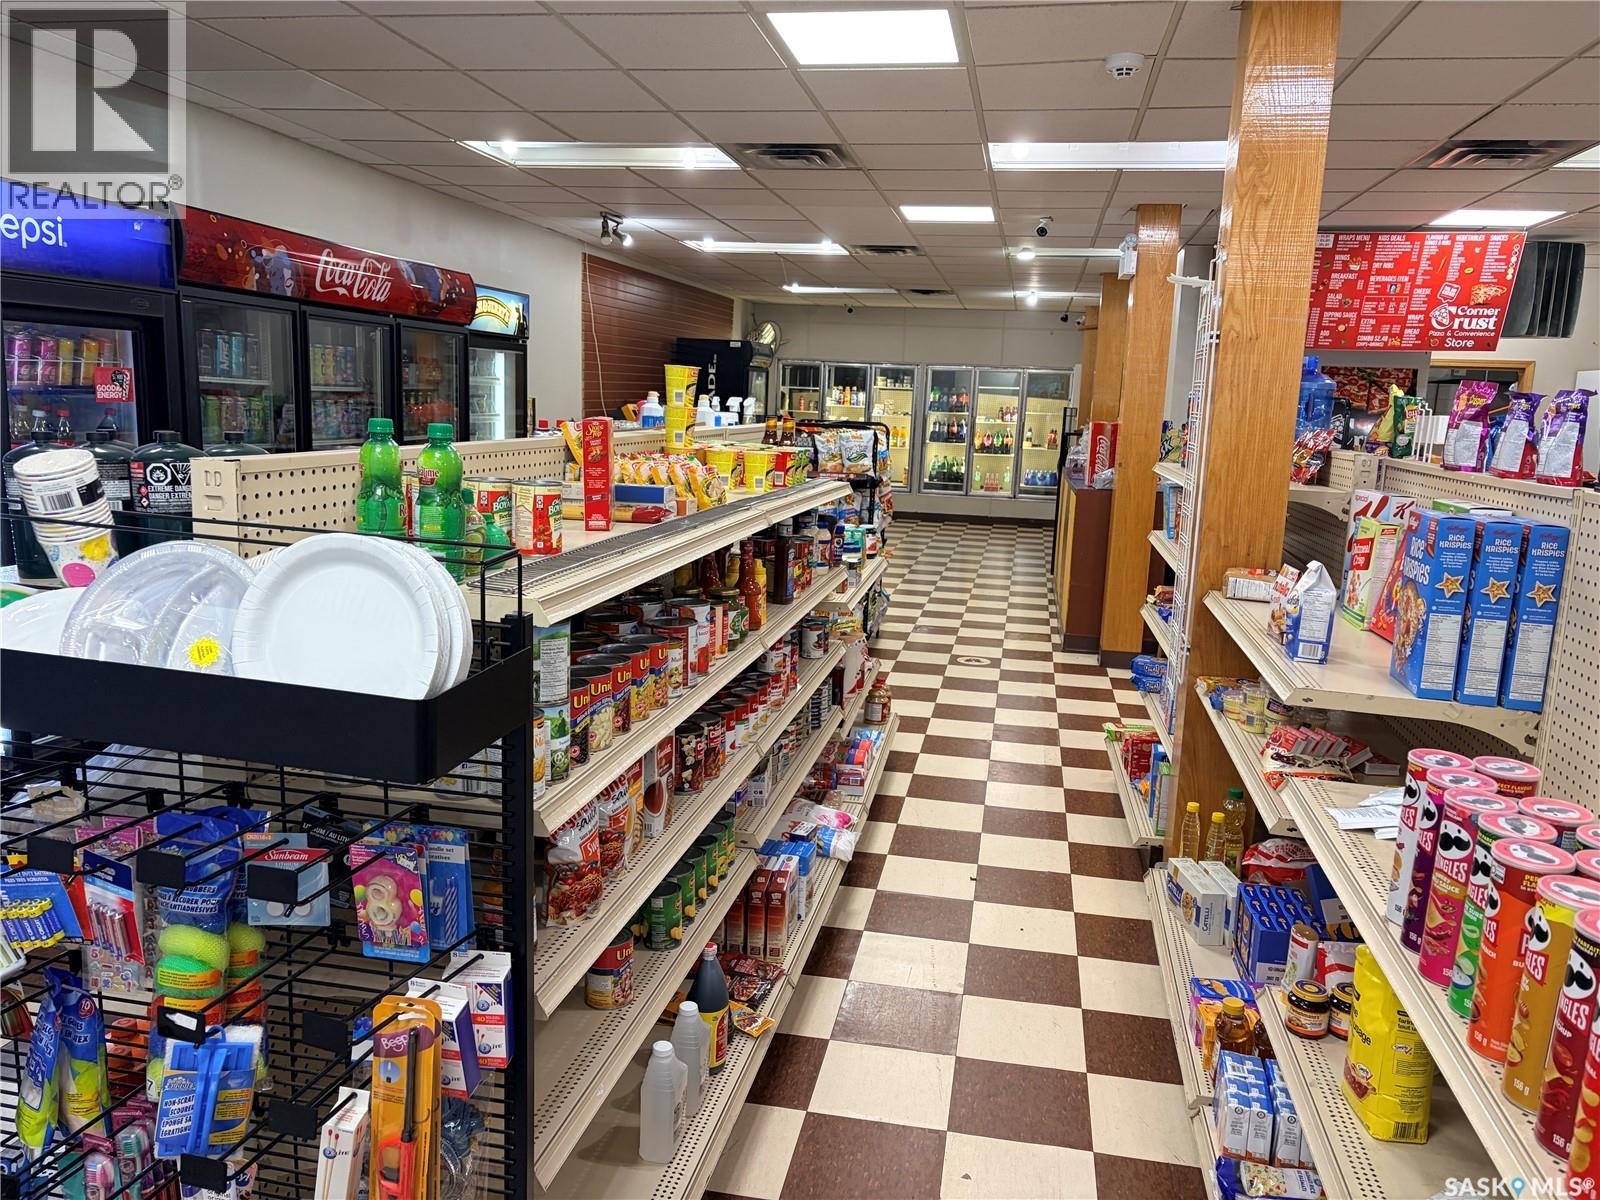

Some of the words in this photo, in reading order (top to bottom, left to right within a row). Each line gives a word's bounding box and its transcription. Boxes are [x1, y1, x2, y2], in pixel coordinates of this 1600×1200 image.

[1457, 306, 1501, 316] Corner
[1444, 338, 1475, 347] Store
[96, 391, 122, 399] ENERGY
[264, 849, 309, 861] Sunbeam
[380, 1034, 409, 1050] Beep
[1474, 1030, 1483, 1042] 156
[1482, 1038, 1488, 1047] g
[1513, 1077, 1524, 1091] 156
[1523, 1086, 1530, 1096] g
[1552, 1133, 1565, 1148] 156
